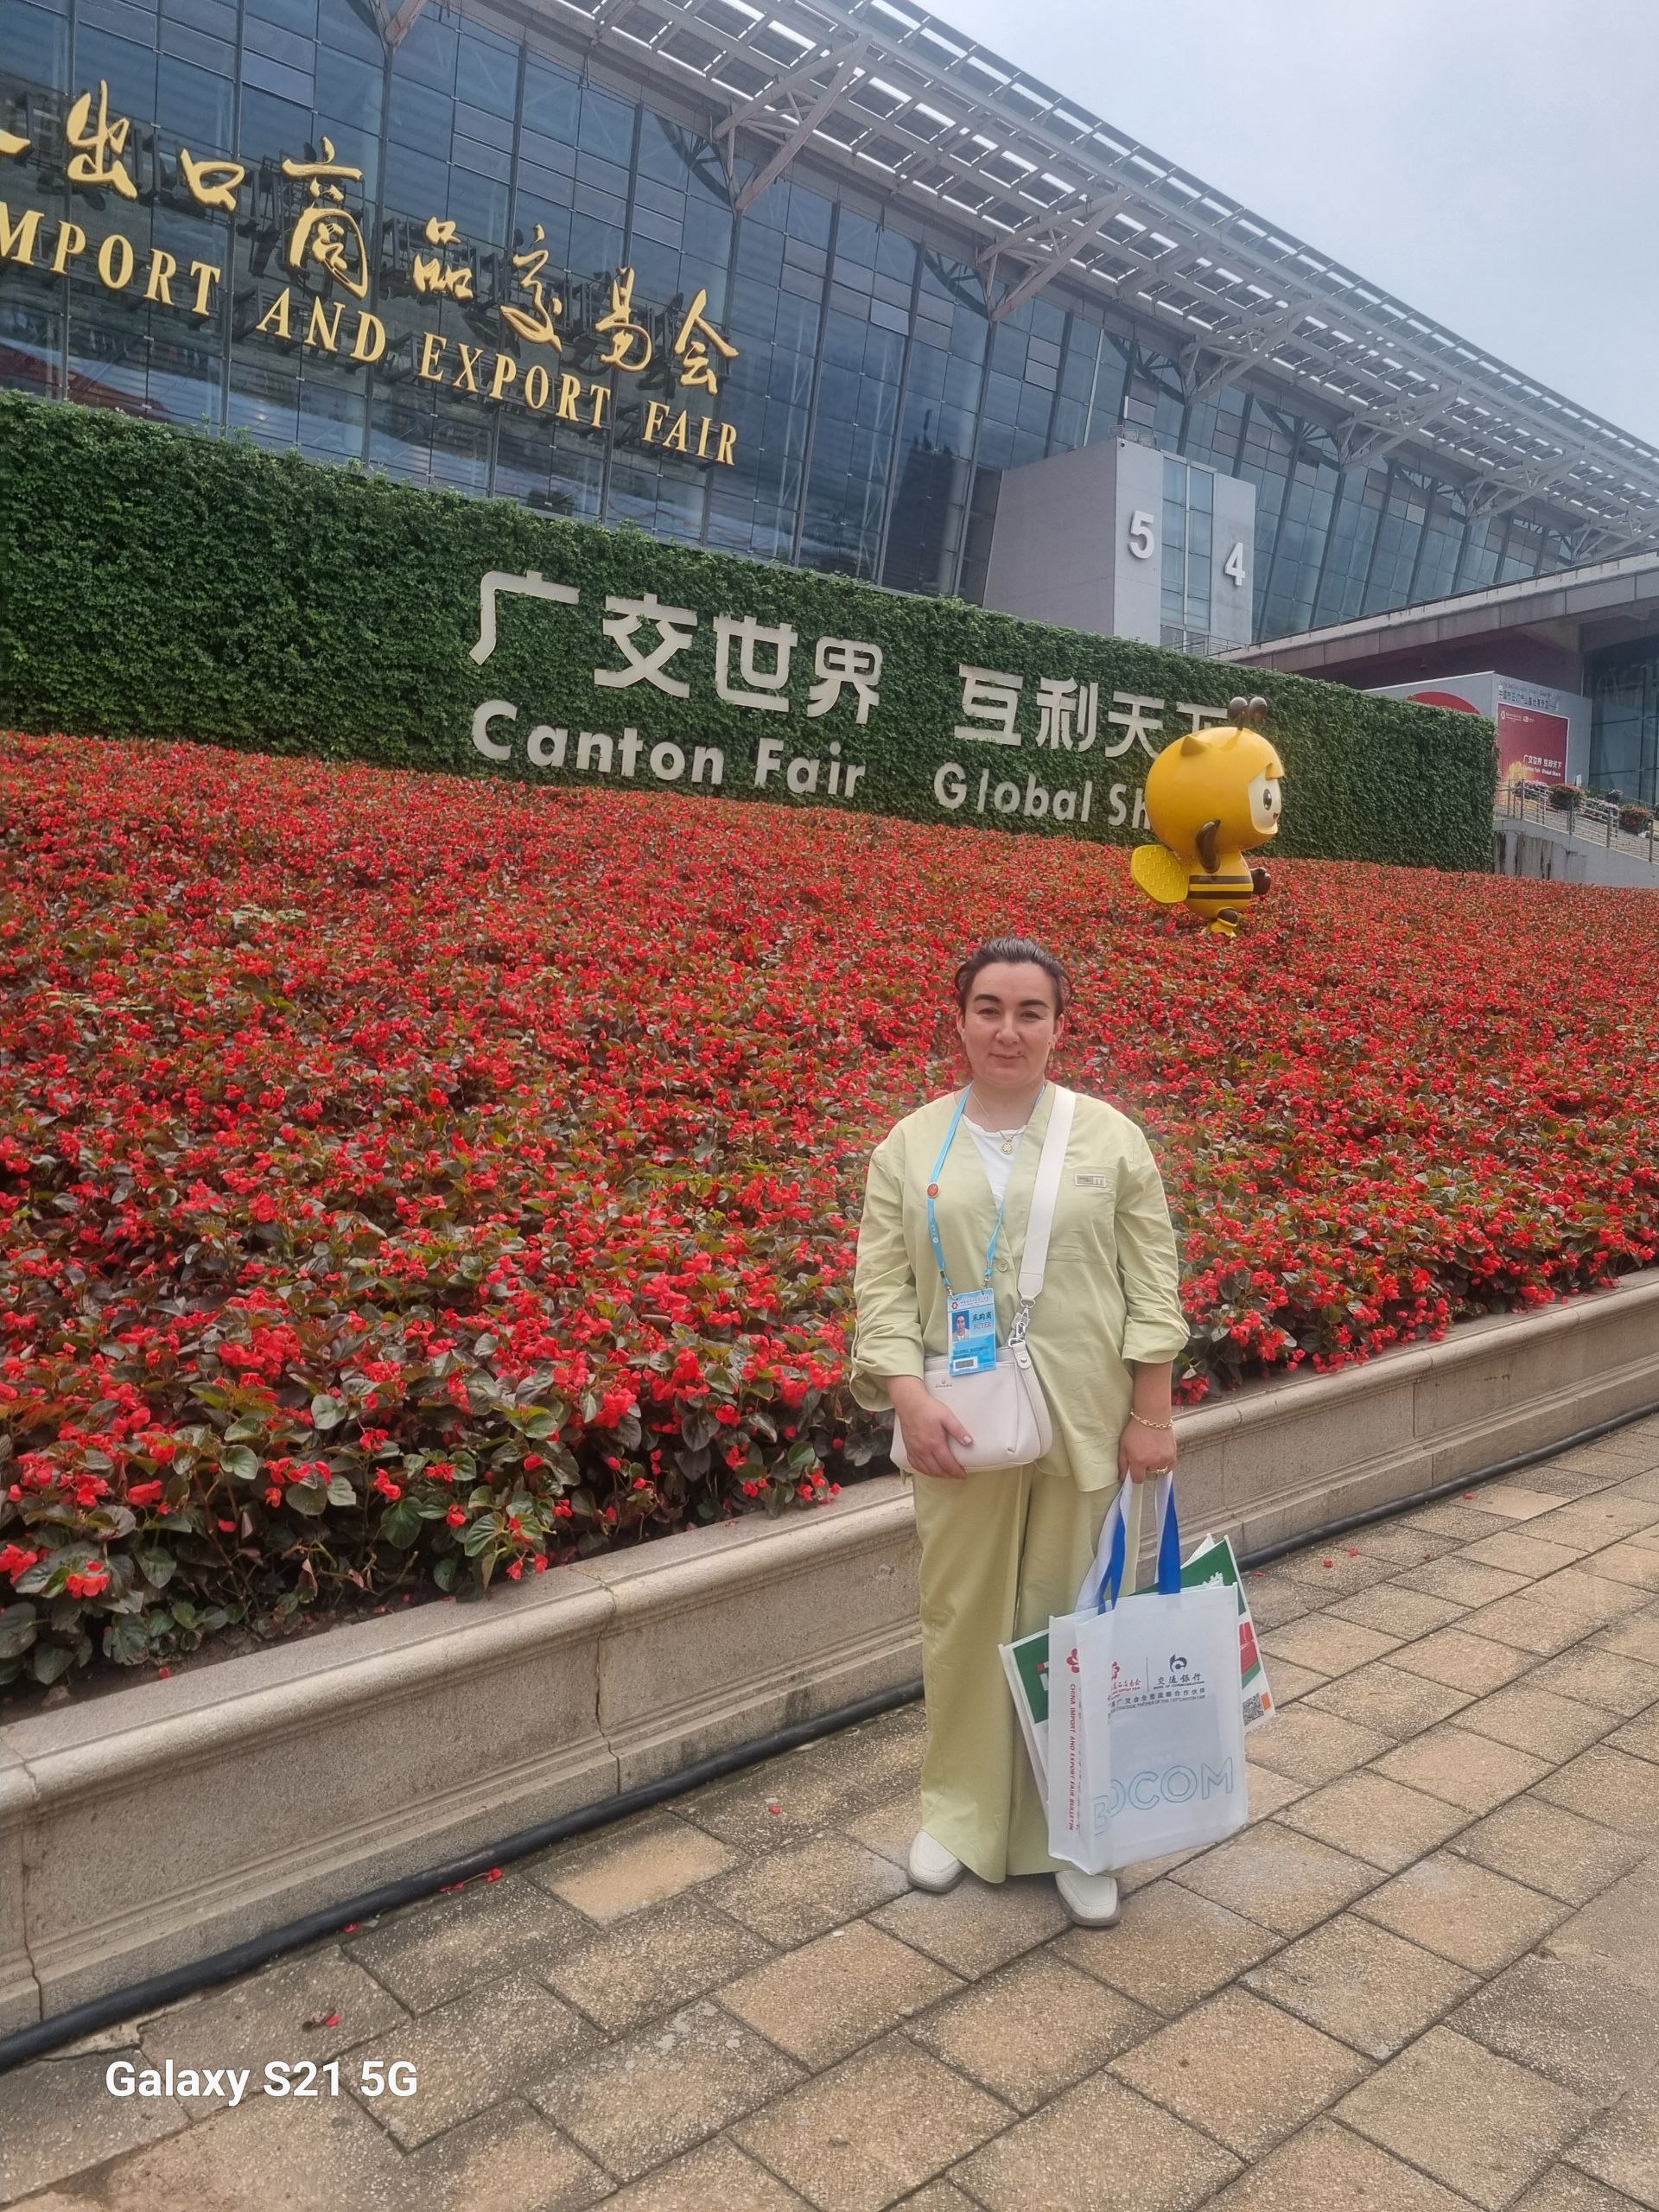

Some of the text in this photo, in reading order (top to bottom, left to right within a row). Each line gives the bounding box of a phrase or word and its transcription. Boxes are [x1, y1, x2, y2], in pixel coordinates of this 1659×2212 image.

[0, 79, 740, 395] 出口商品交易会
[256, 287, 386, 363] AND
[418, 332, 612, 429] EXPORT
[641, 399, 737, 466] FAIR
[1128, 510, 1155, 559] 5
[1224, 542, 1246, 587] 4
[469, 570, 883, 724] 广交世界
[471, 699, 724, 785] Canton
[753, 736, 867, 798] Fair
[934, 762, 1093, 823] Global
